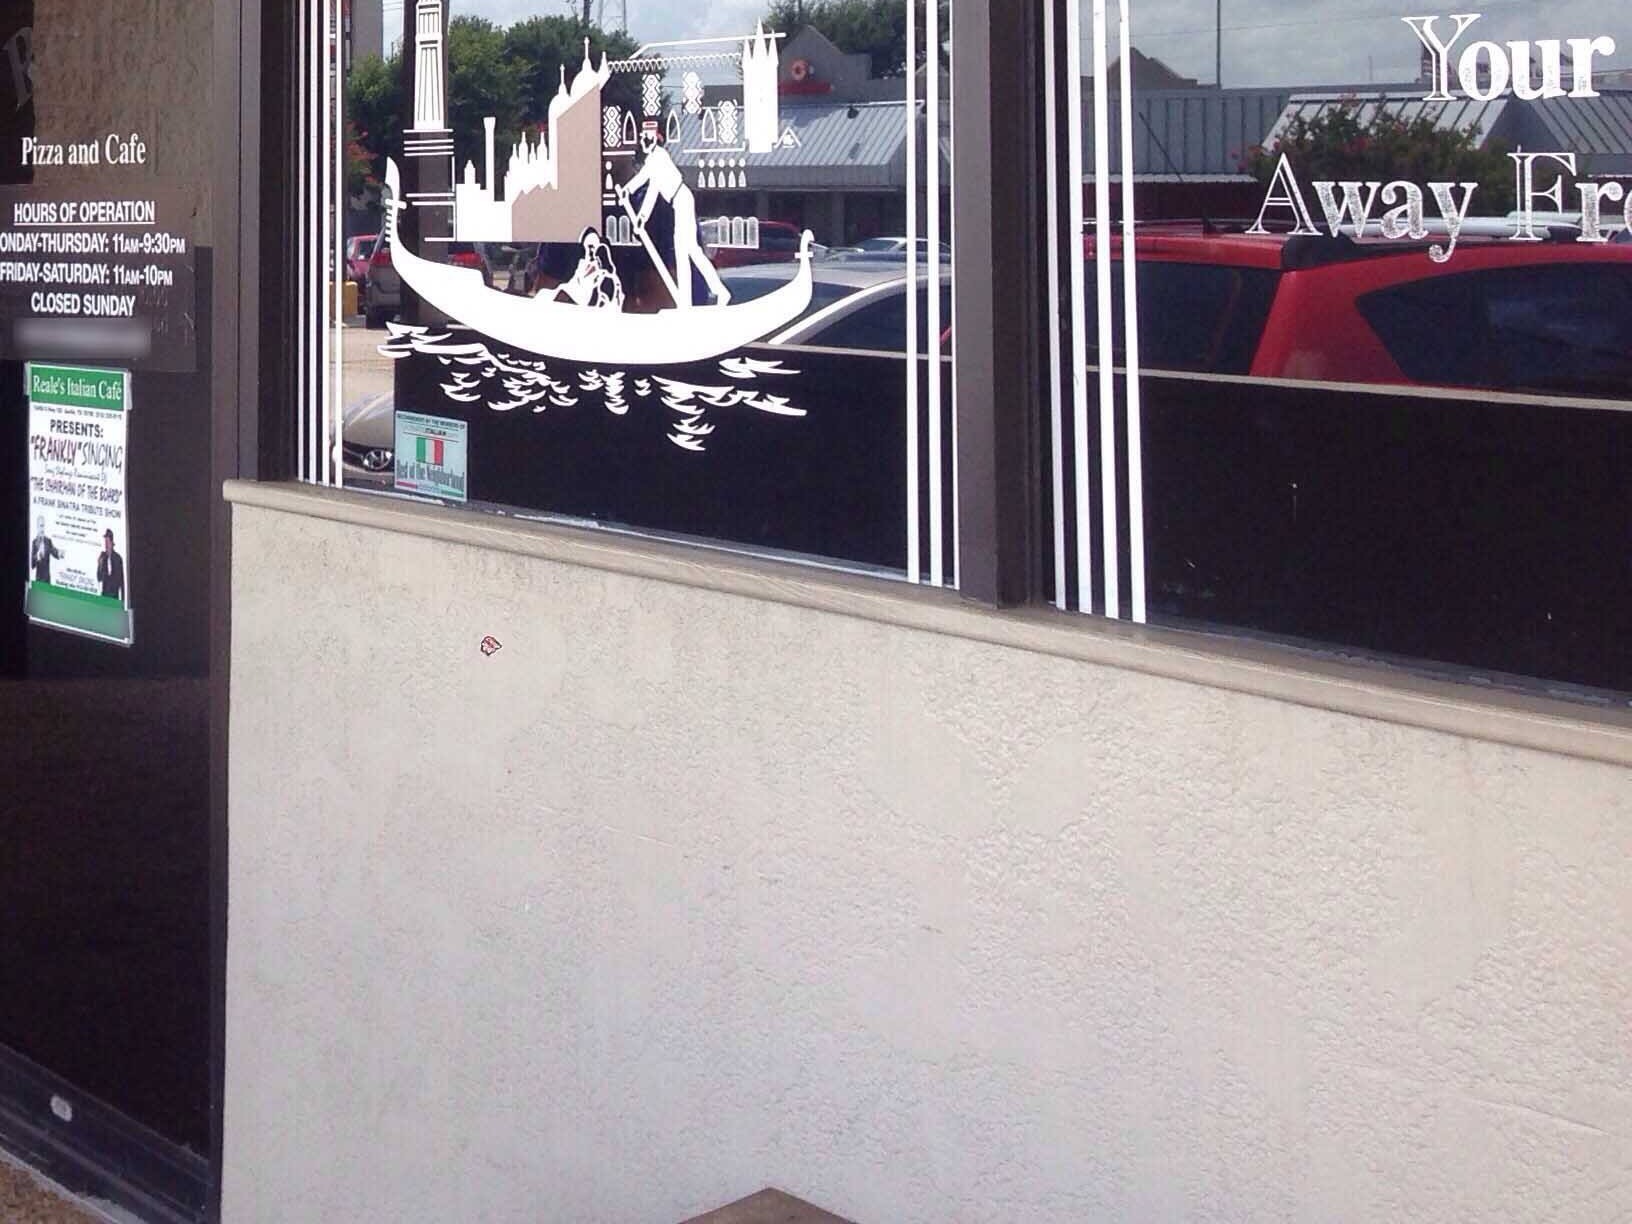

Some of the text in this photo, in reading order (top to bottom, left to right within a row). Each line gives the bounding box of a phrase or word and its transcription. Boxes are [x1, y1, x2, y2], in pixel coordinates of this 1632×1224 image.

[1401, 12, 1617, 102] Your
[21, 132, 147, 166] Pizza and Cafe
[14, 201, 156, 223] HOURS OF OPERATION
[1244, 151, 1632, 263] Away Fr
[0, 262, 111, 285] FRIDAY-SATURDAY:
[31, 292, 137, 317] CLOSED SUNDAY
[33, 374, 66, 396] Reale's
[67, 377, 97, 398] Italian
[49, 418, 104, 439] PRESENTS:
